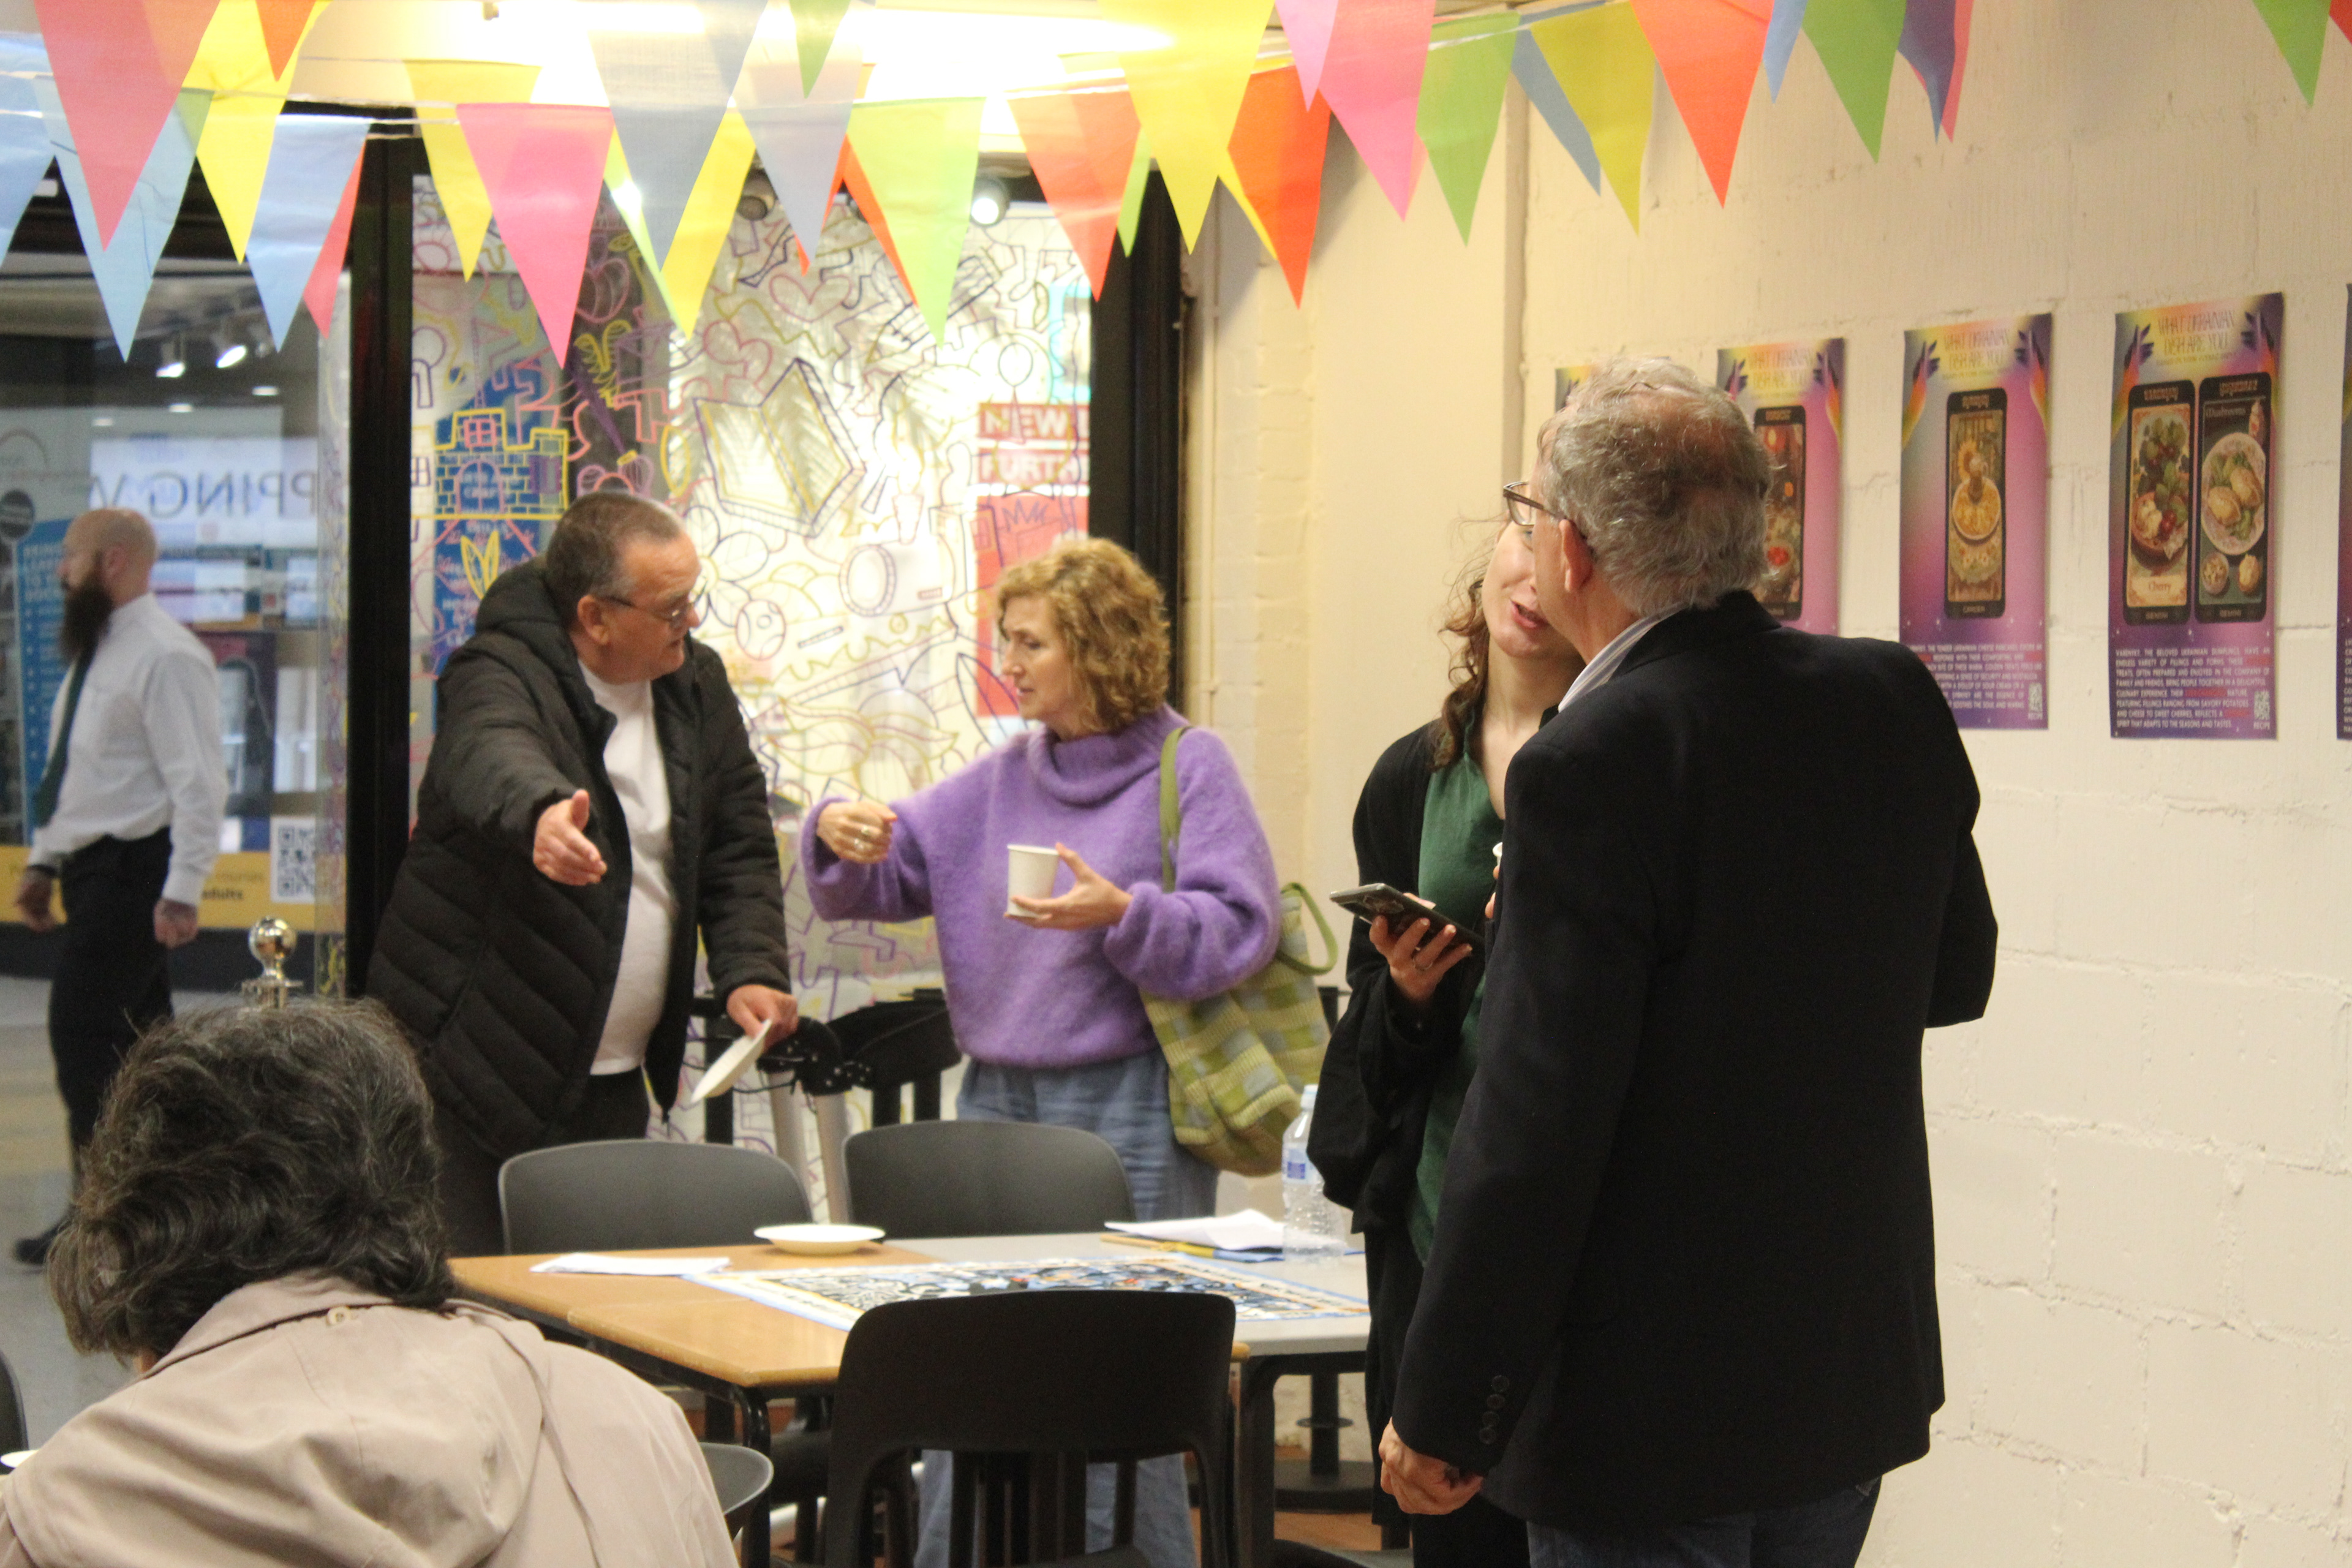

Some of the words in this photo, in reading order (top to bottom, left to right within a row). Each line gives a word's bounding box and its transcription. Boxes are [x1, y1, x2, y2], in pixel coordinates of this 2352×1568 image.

[985, 407, 1068, 437] NEW
[2144, 647, 2153, 656] THE
[2157, 647, 2177, 656] BELOVED
[2181, 647, 2208, 655] UKRAINIAN
[2244, 646, 2258, 655] HAVE
[2263, 646, 2270, 655] AN
[2138, 658, 2156, 666] VARIETY
[2160, 658, 2167, 666] OF
[2193, 657, 2203, 666] AND
[2225, 677, 2231, 686] IN
[2117, 709, 2127, 718] AND
[2128, 709, 2144, 718] CHEESE
[2147, 709, 2153, 718] TO
[2155, 709, 2169, 718] SWEET
